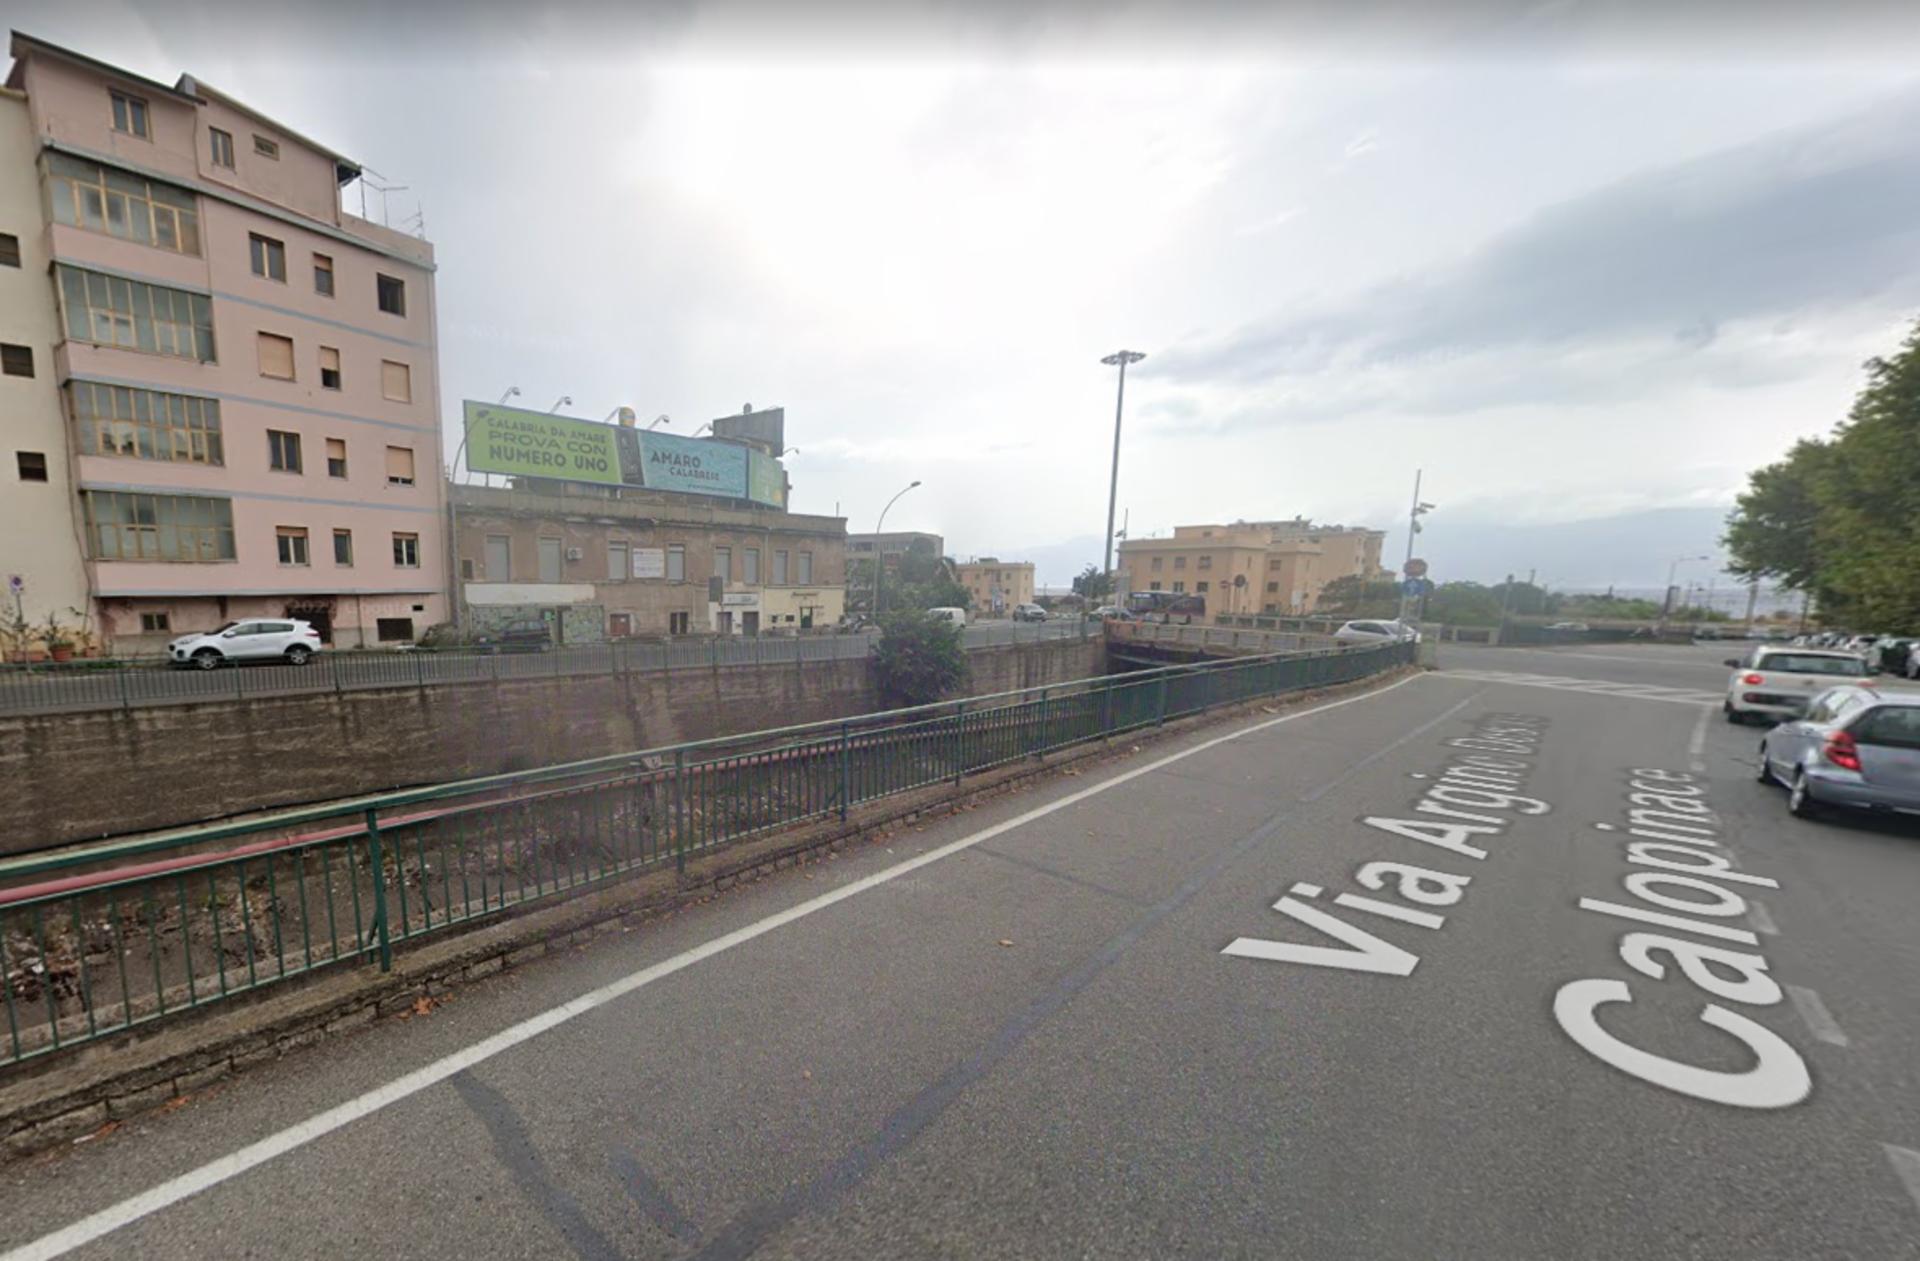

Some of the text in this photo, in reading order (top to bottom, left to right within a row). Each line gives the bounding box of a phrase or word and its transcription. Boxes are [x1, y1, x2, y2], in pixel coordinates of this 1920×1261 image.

[487, 418, 546, 435] CALABRIA
[550, 426, 566, 438] DA
[488, 430, 607, 457] PROVA CON
[489, 445, 608, 473] NUMERO UNO
[651, 451, 701, 469] AMARO
